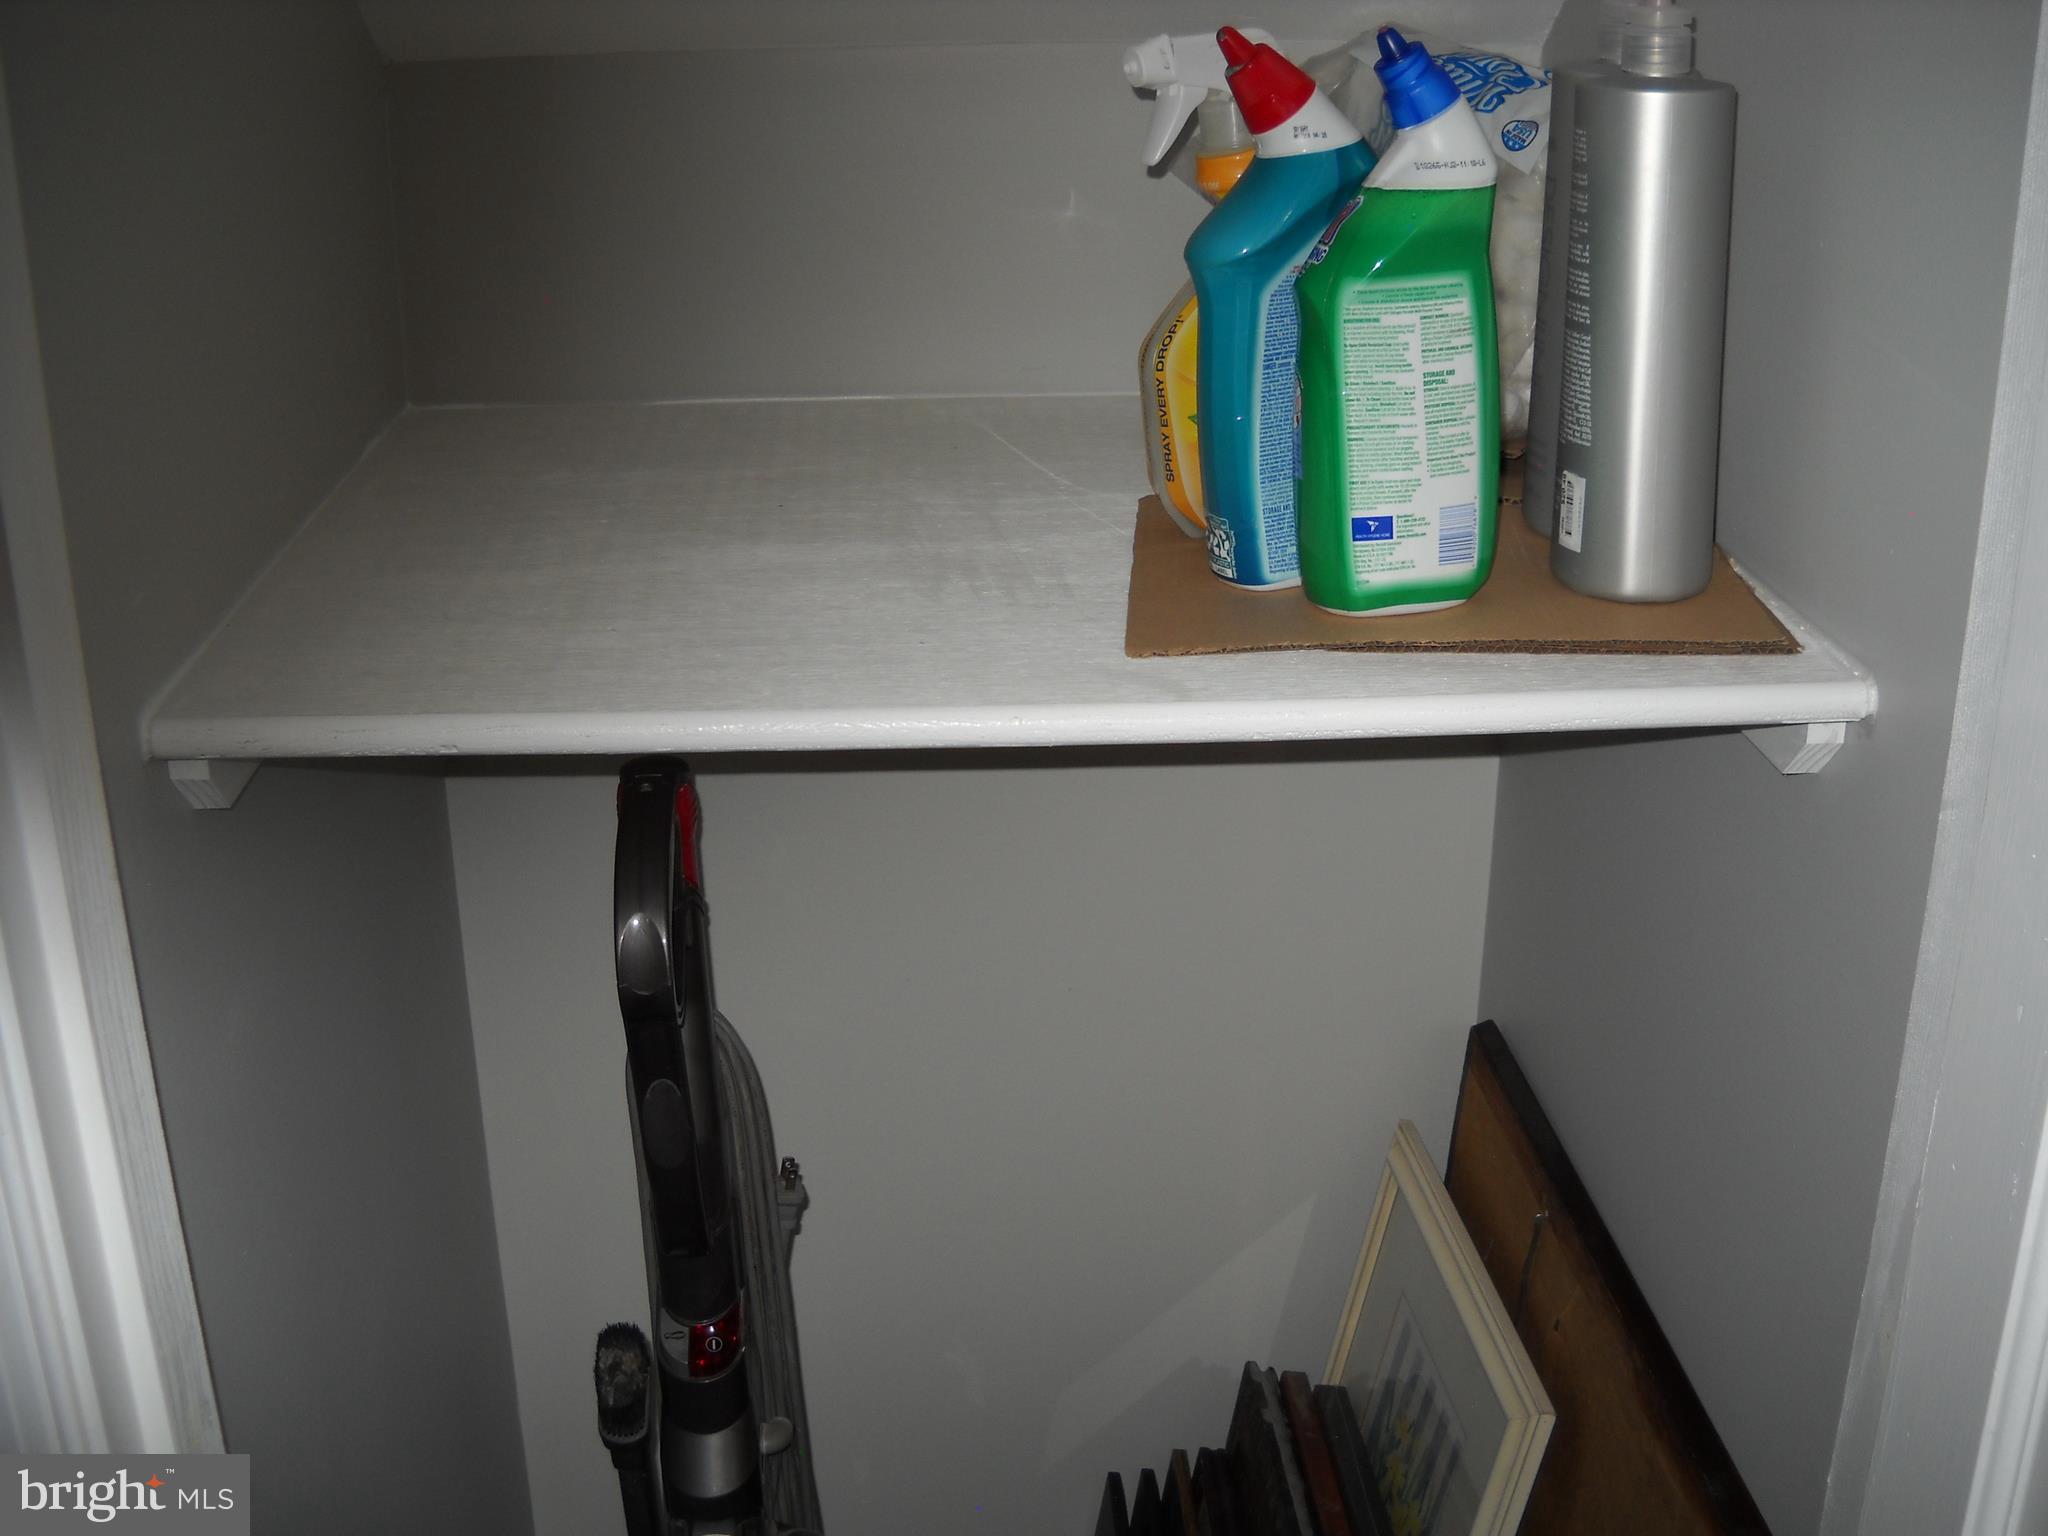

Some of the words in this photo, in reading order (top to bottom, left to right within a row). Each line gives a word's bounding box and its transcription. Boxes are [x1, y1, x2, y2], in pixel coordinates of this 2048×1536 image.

[1512, 123, 1533, 140] USA
[1155, 318, 1185, 372] DROP!
[1423, 369, 1445, 379] STORAGE
[1445, 369, 1456, 377] AND
[1423, 378, 1449, 387] DISPOSAL:
[1157, 378, 1169, 428] EVERY
[1160, 433, 1175, 483] SPRAY
[1262, 504, 1282, 515] STORAGE
